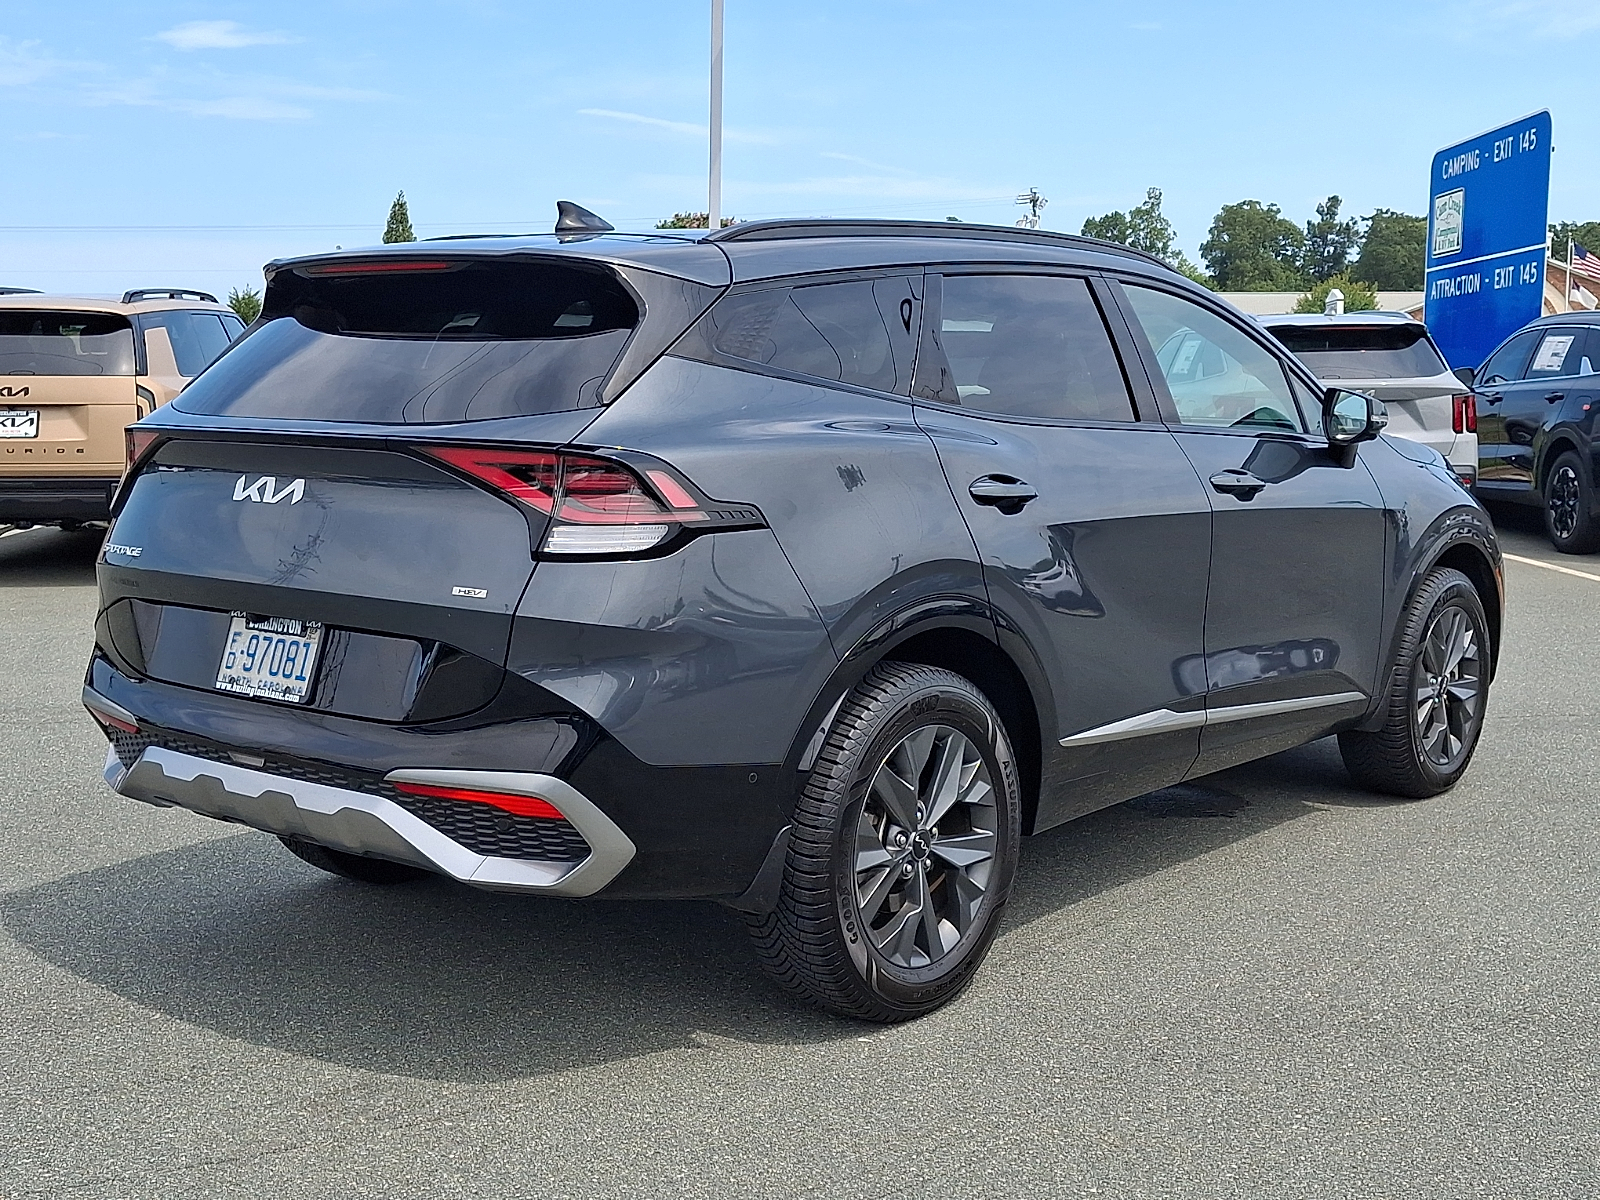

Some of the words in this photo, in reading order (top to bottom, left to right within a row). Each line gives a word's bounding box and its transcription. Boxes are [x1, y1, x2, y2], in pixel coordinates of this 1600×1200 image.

[1442, 149, 1480, 180] CAMPING
[1493, 136, 1514, 163] EXIT
[1519, 128, 1537, 153] 145
[1431, 273, 1481, 300] ATTRACTION
[1494, 266, 1514, 289] EXIT
[1519, 262, 1538, 286] 145
[232, 474, 306, 505] KIA
[458, 588, 482, 596] HEV
[242, 634, 311, 682] 97081
[257, 679, 303, 694] CAROLNA
